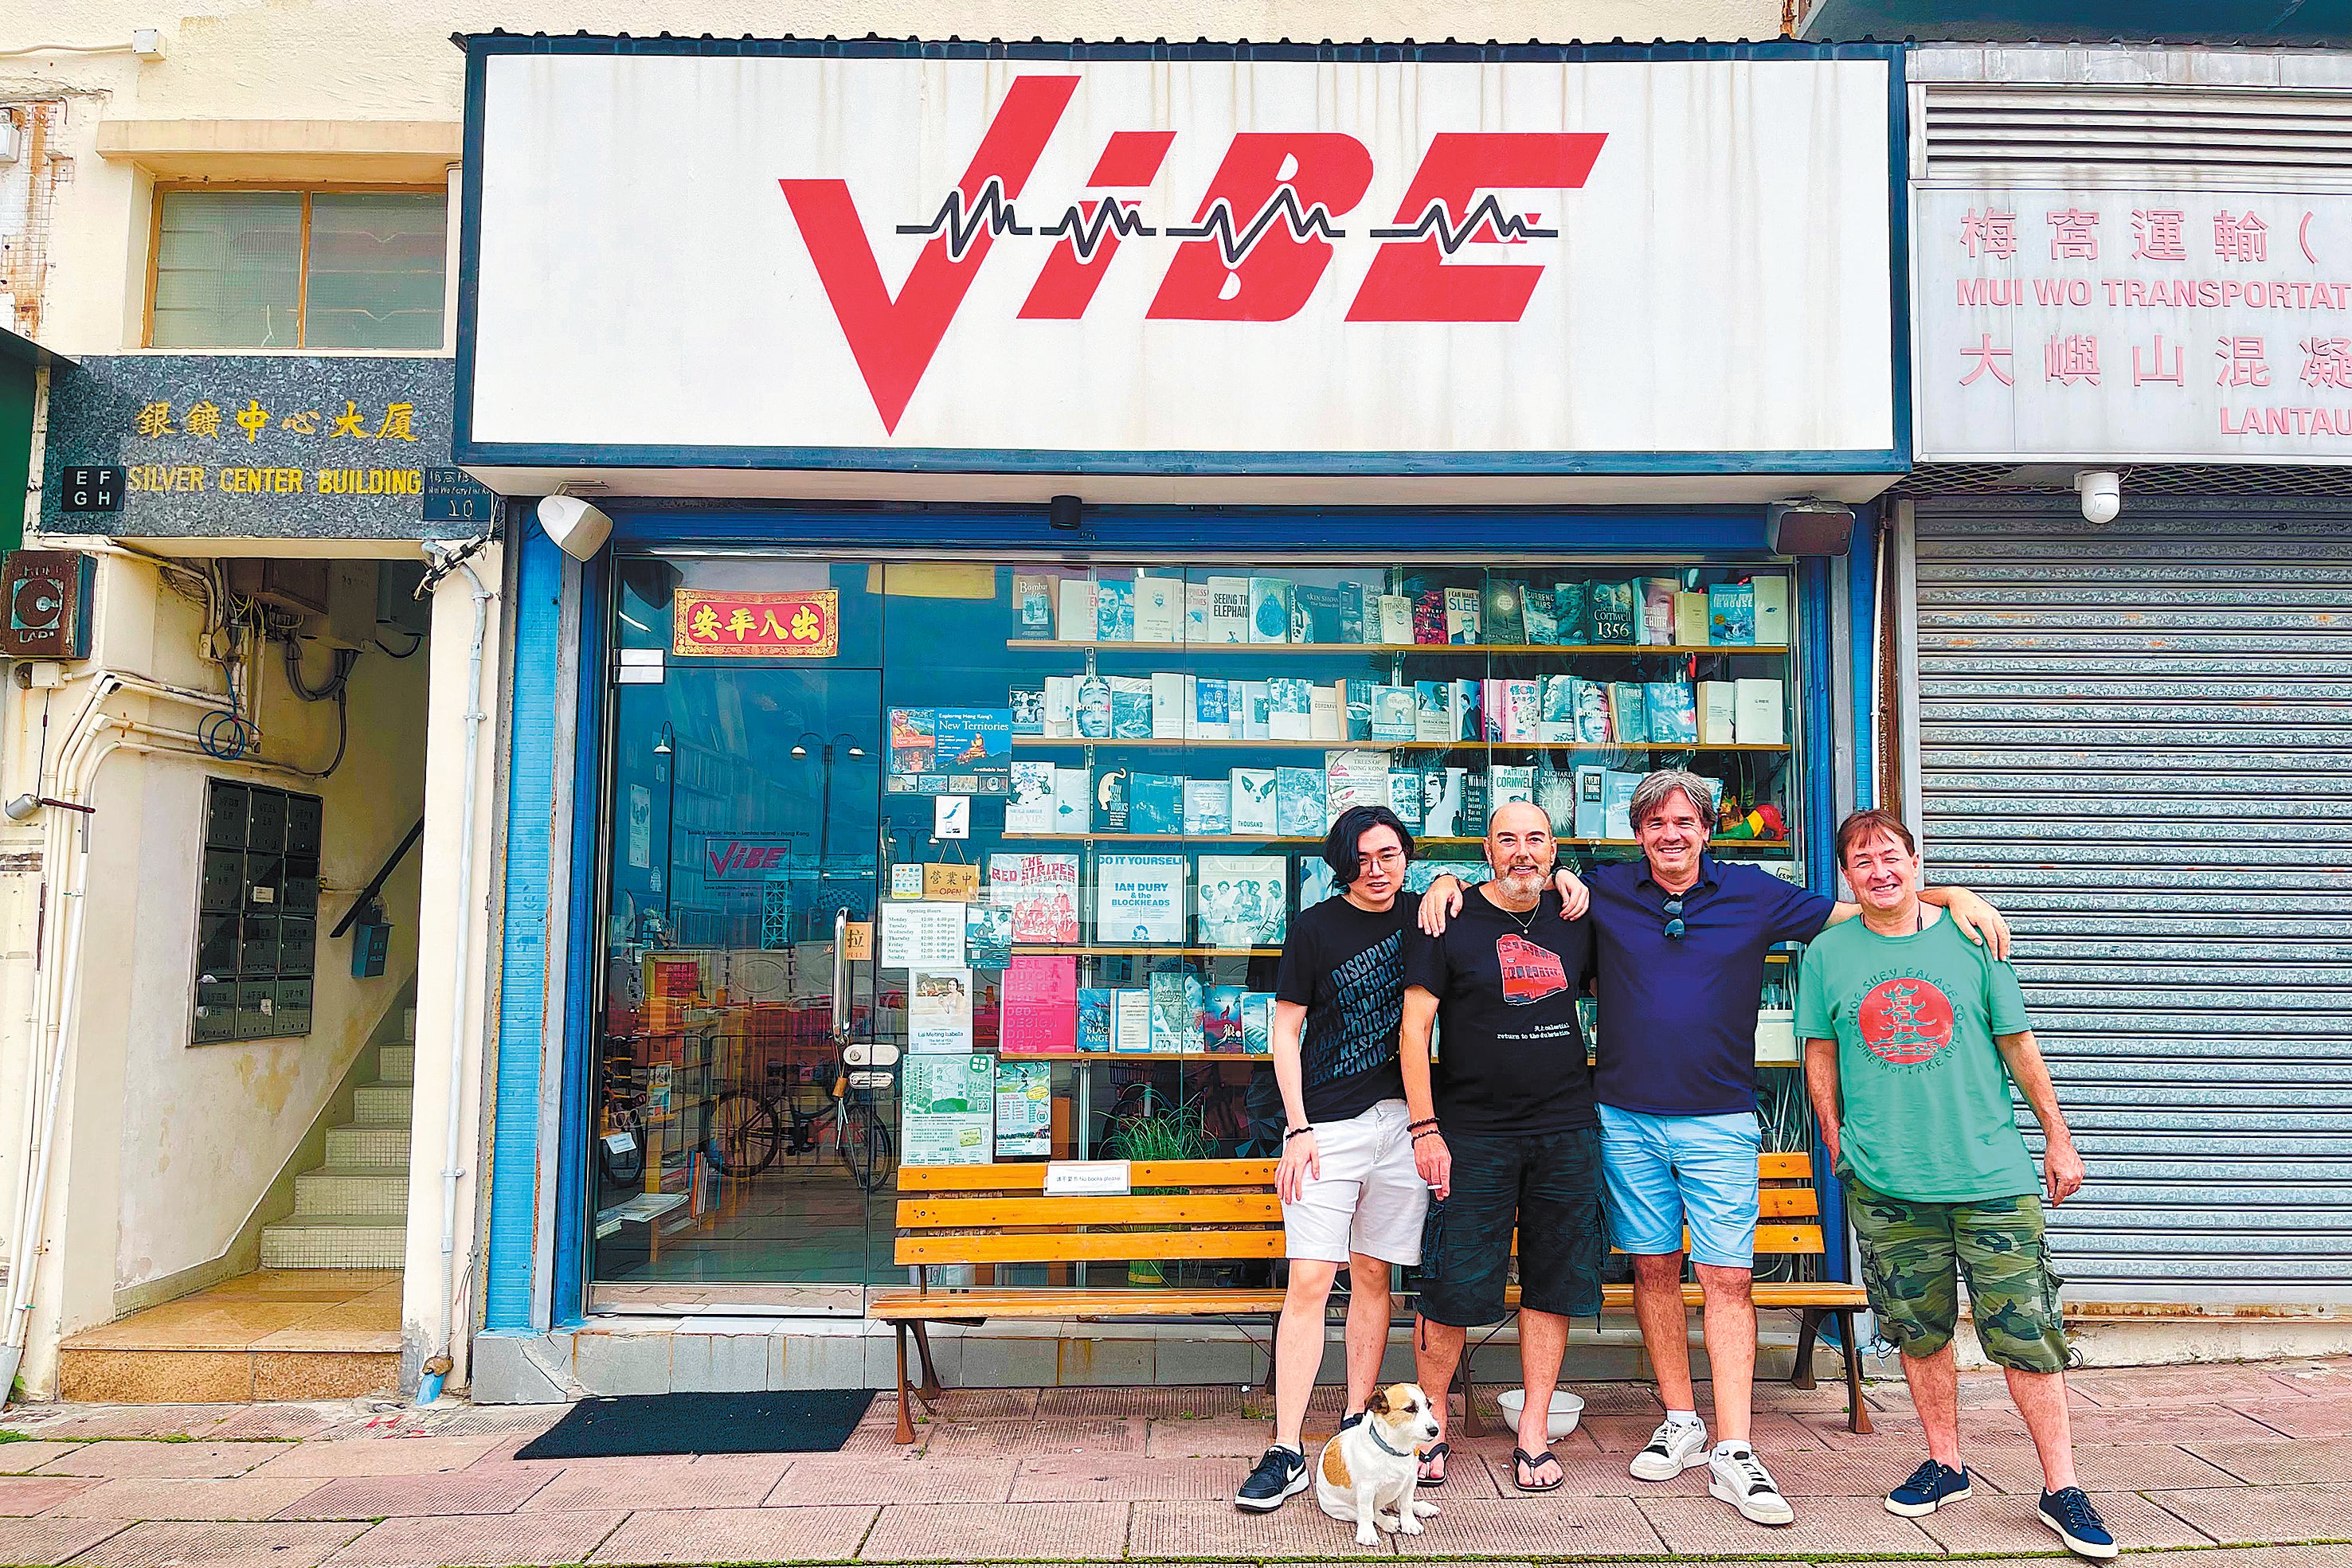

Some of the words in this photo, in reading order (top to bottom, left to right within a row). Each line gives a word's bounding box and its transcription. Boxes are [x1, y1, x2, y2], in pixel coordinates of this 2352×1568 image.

[1957, 278, 2025, 306] MUI
[2033, 279, 2092, 306] WO
[76, 471, 88, 485] E
[100, 471, 112, 485] F
[128, 465, 205, 493] SILVER
[220, 467, 304, 494] CENTER
[318, 468, 422, 495] BUILDING
[73, 491, 88, 506] G
[97, 491, 110, 506] H
[1213, 592, 1239, 606] SEEING
[1535, 600, 1552, 610] WARS
[1594, 609, 1631, 621] Cornwell
[1643, 616, 1668, 628] CHINA
[1597, 622, 1630, 639] 1356
[939, 721, 961, 730] New
[962, 720, 1009, 731] Territories
[1503, 768, 1529, 777] PATRICIA
[1541, 797, 1575, 811] GOD
[1020, 854, 1043, 869] THE
[1115, 856, 1125, 866] IT
[929, 870, 972, 886] 營業中
[991, 866, 1018, 882] RED
[1020, 862, 1076, 881] STRIPES
[939, 887, 962, 896] OPEN
[1114, 882, 1135, 892] IAN
[1137, 882, 1169, 892] DURY
[847, 929, 865, 948] 拉
[1862, 968, 1897, 991] SUEY
[1333, 1042, 1388, 1078] HONOR
[1856, 1040, 1878, 1065] DINE
[1878, 1060, 1889, 1071] IN
[1907, 1057, 1944, 1075] TAKE
